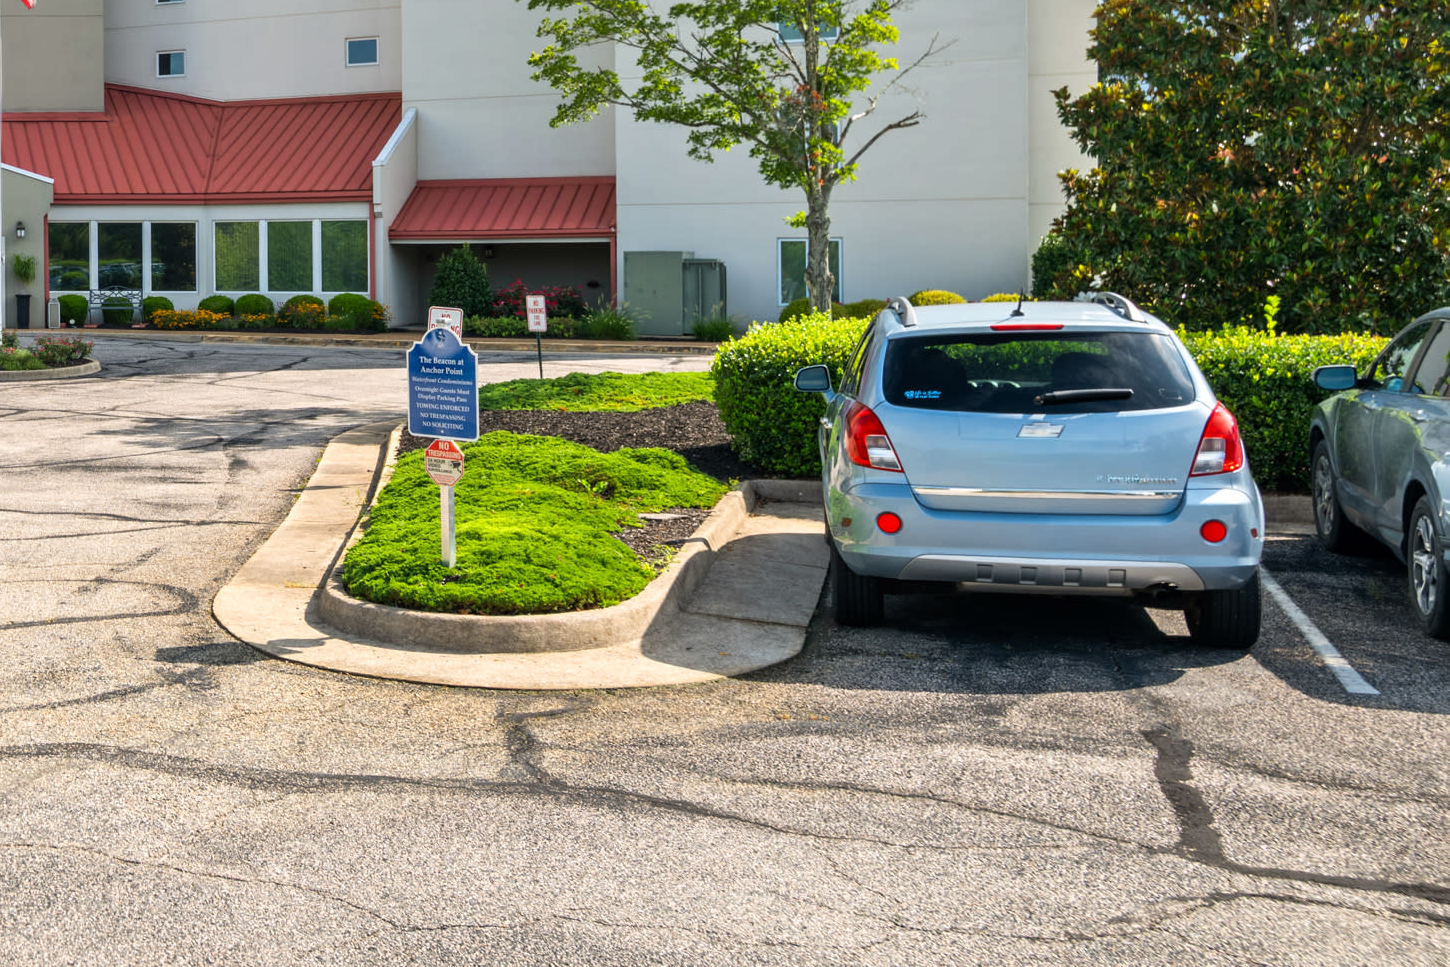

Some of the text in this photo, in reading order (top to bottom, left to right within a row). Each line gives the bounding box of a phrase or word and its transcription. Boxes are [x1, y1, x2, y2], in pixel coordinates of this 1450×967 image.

[419, 356, 432, 364] The
[433, 357, 456, 365] Beacon
[420, 366, 463, 375] Anchor Point
[412, 376, 437, 384] Waterfront
[416, 402, 470, 412] TOWING ENFORCED
[429, 413, 466, 421] TRESPASSING
[432, 422, 464, 430] SOLICITING
[438, 442, 450, 450] NO
